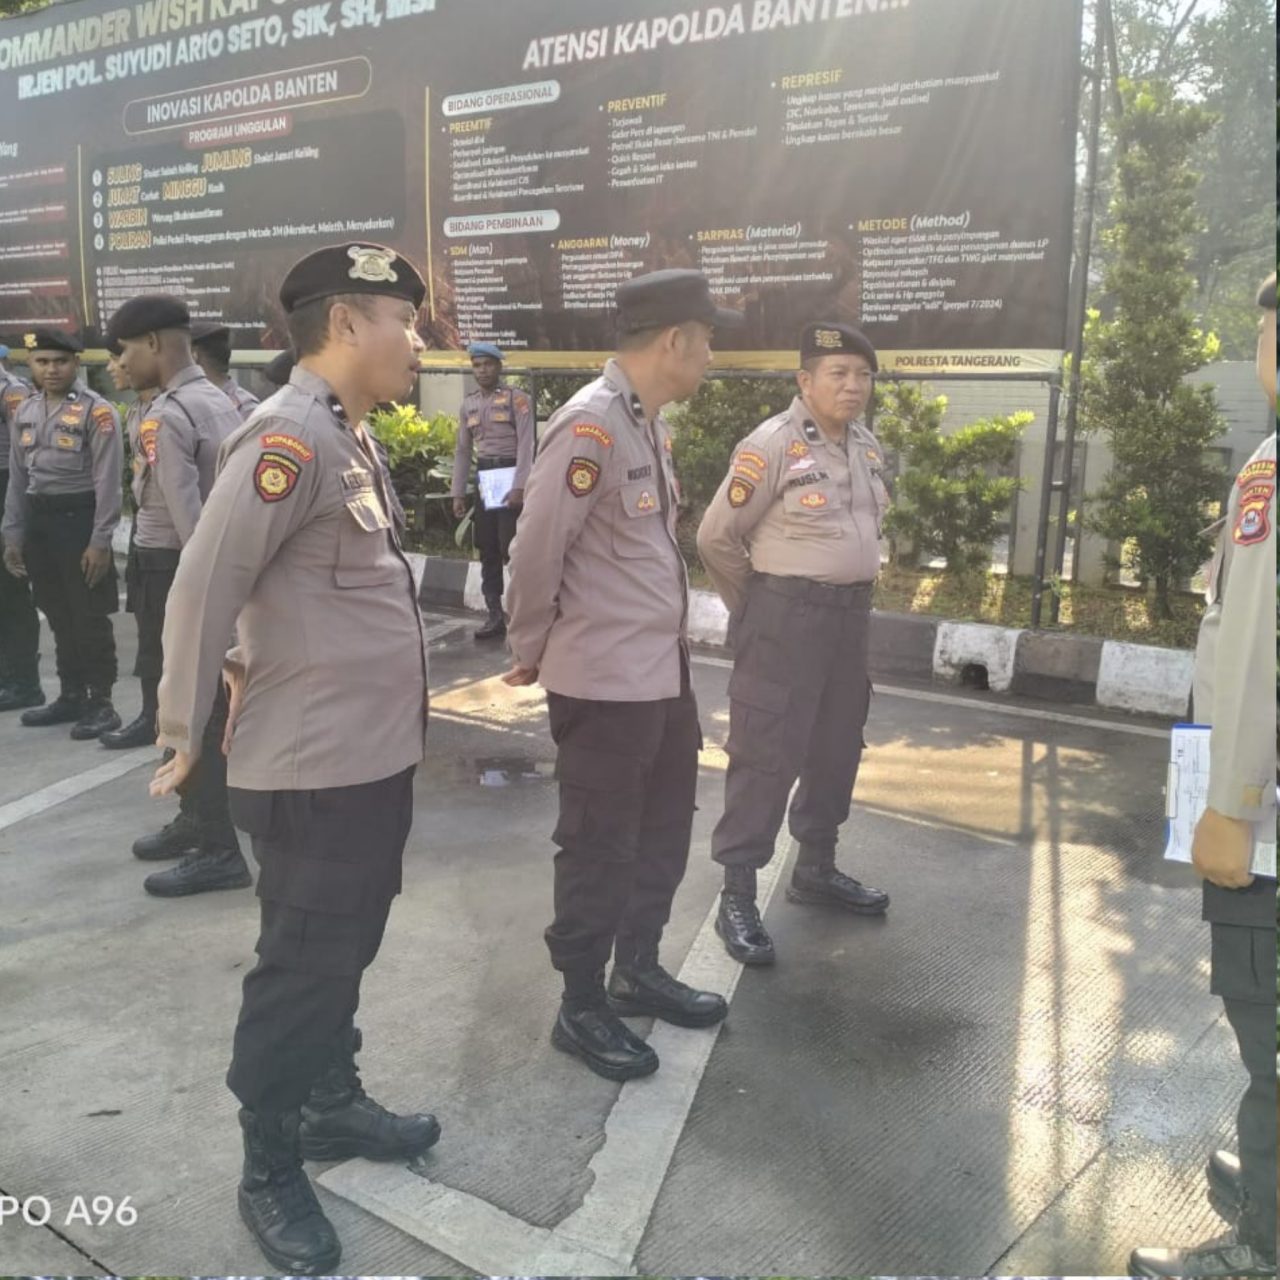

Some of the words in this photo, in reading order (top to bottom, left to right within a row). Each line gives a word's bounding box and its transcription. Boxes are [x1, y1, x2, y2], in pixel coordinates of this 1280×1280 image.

[135, 0, 204, 38] WISH
[522, 28, 607, 71] ATENSI
[613, 6, 747, 56] KAPOLDA
[18, 66, 64, 100] IRJEN
[105, 40, 172, 81] SUYUDI
[174, 29, 224, 66] ARIO
[227, 15, 288, 54] SETO,
[292, 2, 337, 39] SIK,
[781, 68, 843, 90] REPRESIF
[147, 94, 202, 124] INOVASI
[203, 81, 271, 116] KAPOLDA
[274, 70, 338, 102] BANTEN
[448, 96, 483, 112] BIDANG
[485, 86, 554, 106] OPERASIONAL
[607, 93, 668, 113] PREVENTIF
[189, 125, 233, 144] PROGRAM
[234, 117, 287, 137] UNGGULAN
[450, 117, 494, 134] PREEMTIF
[201, 146, 252, 174] JUMLING
[162, 176, 208, 201] MINGGU
[109, 207, 148, 229] WARBIN
[449, 219, 485, 233] BIDANG
[486, 215, 544, 231] PEMBINAAN
[858, 217, 908, 232] METODE
[910, 210, 971, 231] (Method)
[557, 236, 609, 251] ANGGARAN
[610, 230, 650, 250] (Money)
[697, 227, 744, 242] SARPRAS
[745, 221, 802, 241] (Material)
[468, 240, 493, 257] (Man)
[896, 355, 949, 369] POLRESTA
[950, 354, 1022, 368] TANGERANG
